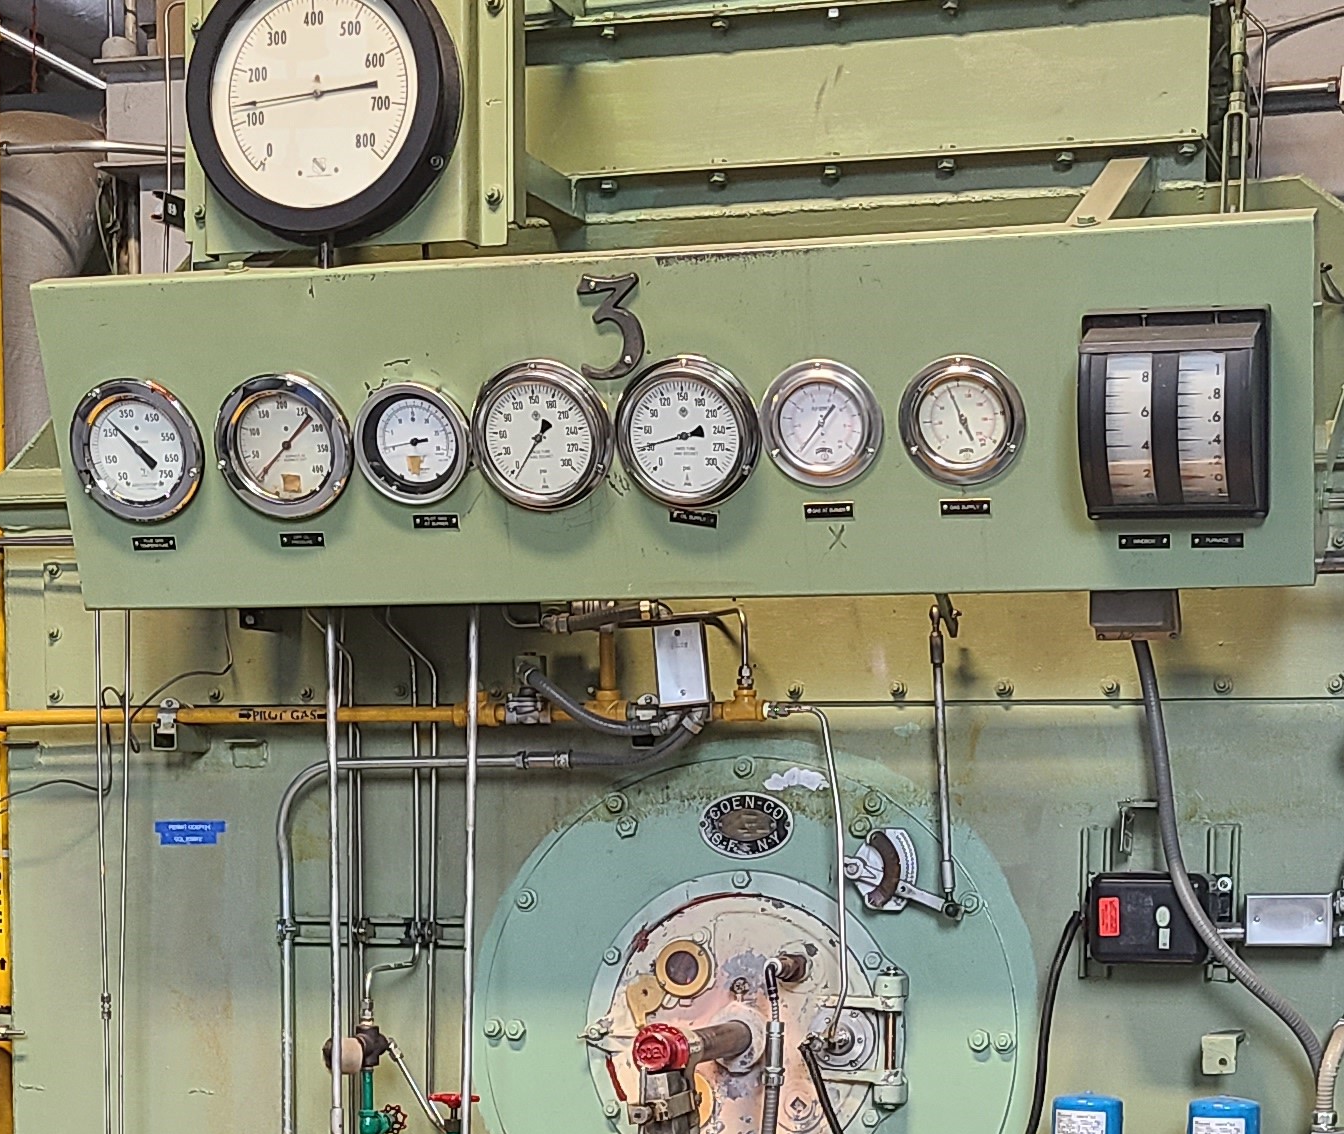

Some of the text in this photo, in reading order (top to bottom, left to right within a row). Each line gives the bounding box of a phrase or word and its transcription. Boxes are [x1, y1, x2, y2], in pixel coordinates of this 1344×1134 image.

[303, 10, 324, 27] 400
[339, 20, 362, 37] 500
[267, 30, 287, 46] 300
[365, 53, 385, 69] 600
[248, 67, 268, 83] 200
[370, 96, 390, 112] 700
[246, 111, 265, 126] 100
[355, 132, 376, 148] 800
[266, 143, 273, 158] 0
[577, 272, 645, 380] 3
[1216, 364, 1220, 376] 1
[1141, 371, 1149, 383] 8
[677, 392, 689, 401] 150
[1207, 388, 1221, 400] .8
[529, 395, 540, 405] 150
[546, 400, 557, 409] 180
[659, 397, 671, 406] 120
[694, 397, 706, 407] 180
[276, 401, 288, 410] 200
[512, 400, 524, 410] 120
[119, 408, 134, 418] 350
[258, 410, 270, 418] 150
[296, 407, 309, 417] 250
[557, 410, 570, 420] 210
[649, 408, 658, 417] 90
[705, 409, 718, 418] 210
[1141, 407, 1149, 417] 6
[144, 413, 160, 423] 450
[504, 413, 512, 423] 90
[1207, 411, 1221, 423] .6
[249, 427, 260, 436] 100
[311, 423, 324, 433] 300
[566, 427, 578, 435] 240
[643, 426, 652, 434] 60
[713, 425, 725, 434] 240
[103, 428, 118, 438] 250
[160, 432, 176, 441] 550
[499, 430, 508, 439] 60
[1207, 435, 1221, 445] .4
[317, 444, 329, 453] 350
[567, 443, 579, 452] 270
[713, 443, 725, 452] 270
[1140, 441, 1150, 450] 4
[251, 450, 260, 459] 50
[502, 447, 511, 455] 30
[104, 455, 118, 464] 150
[164, 453, 179, 462] 650
[659, 457, 663, 466] 0
[705, 458, 718, 466] 300
[515, 460, 520, 469] 0
[560, 459, 573, 467] 300
[159, 470, 174, 478] 750
[312, 465, 324, 474] 400
[1142, 469, 1151, 478] 2
[118, 472, 128, 481] 50
[252, 710, 317, 721] PILOT GAS
